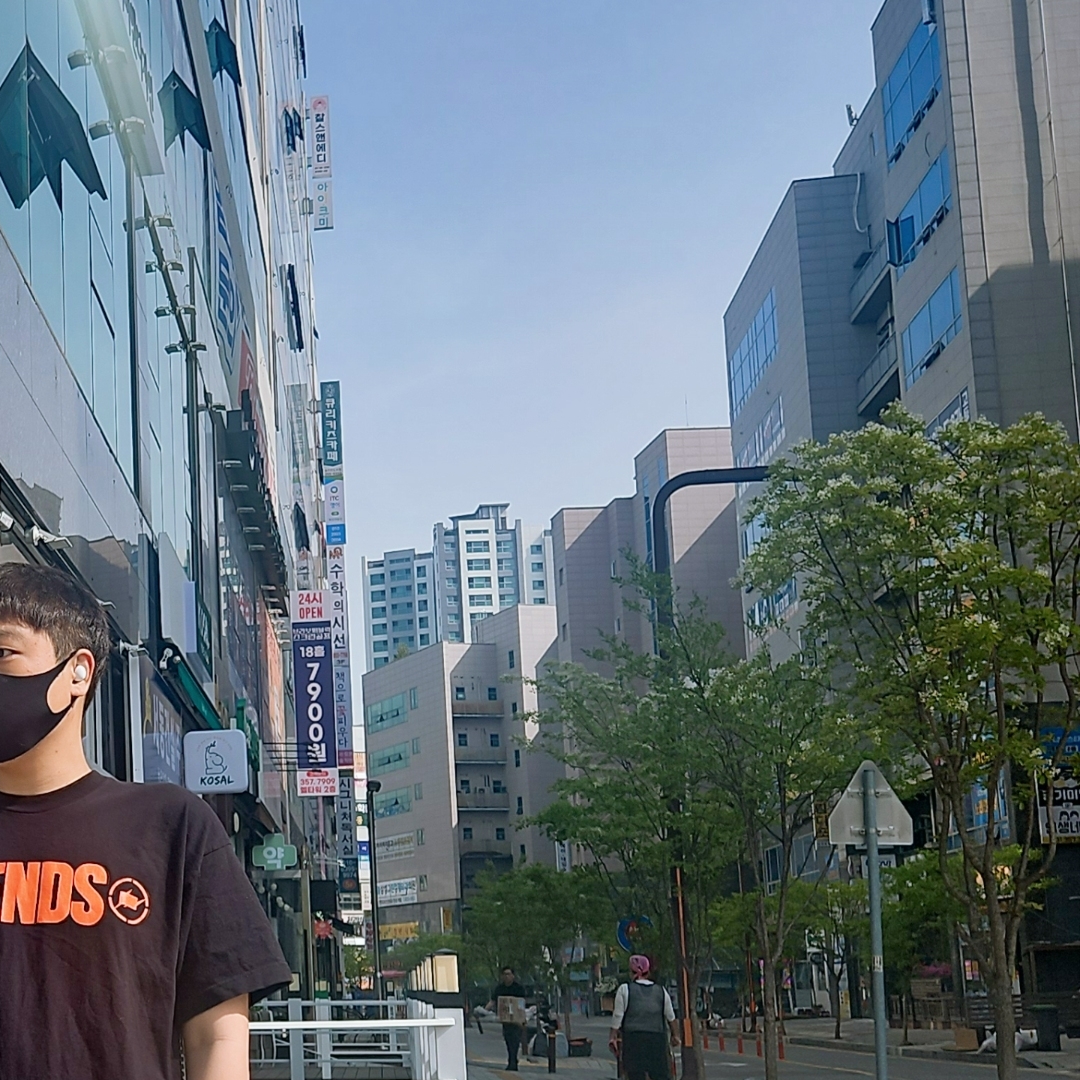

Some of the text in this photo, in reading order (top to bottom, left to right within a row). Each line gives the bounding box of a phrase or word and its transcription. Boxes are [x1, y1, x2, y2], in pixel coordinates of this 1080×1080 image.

[298, 592, 323, 605] 24시
[299, 607, 323, 619] OPEN
[200, 775, 234, 786] KOSAL
[262, 846, 285, 869] 약
